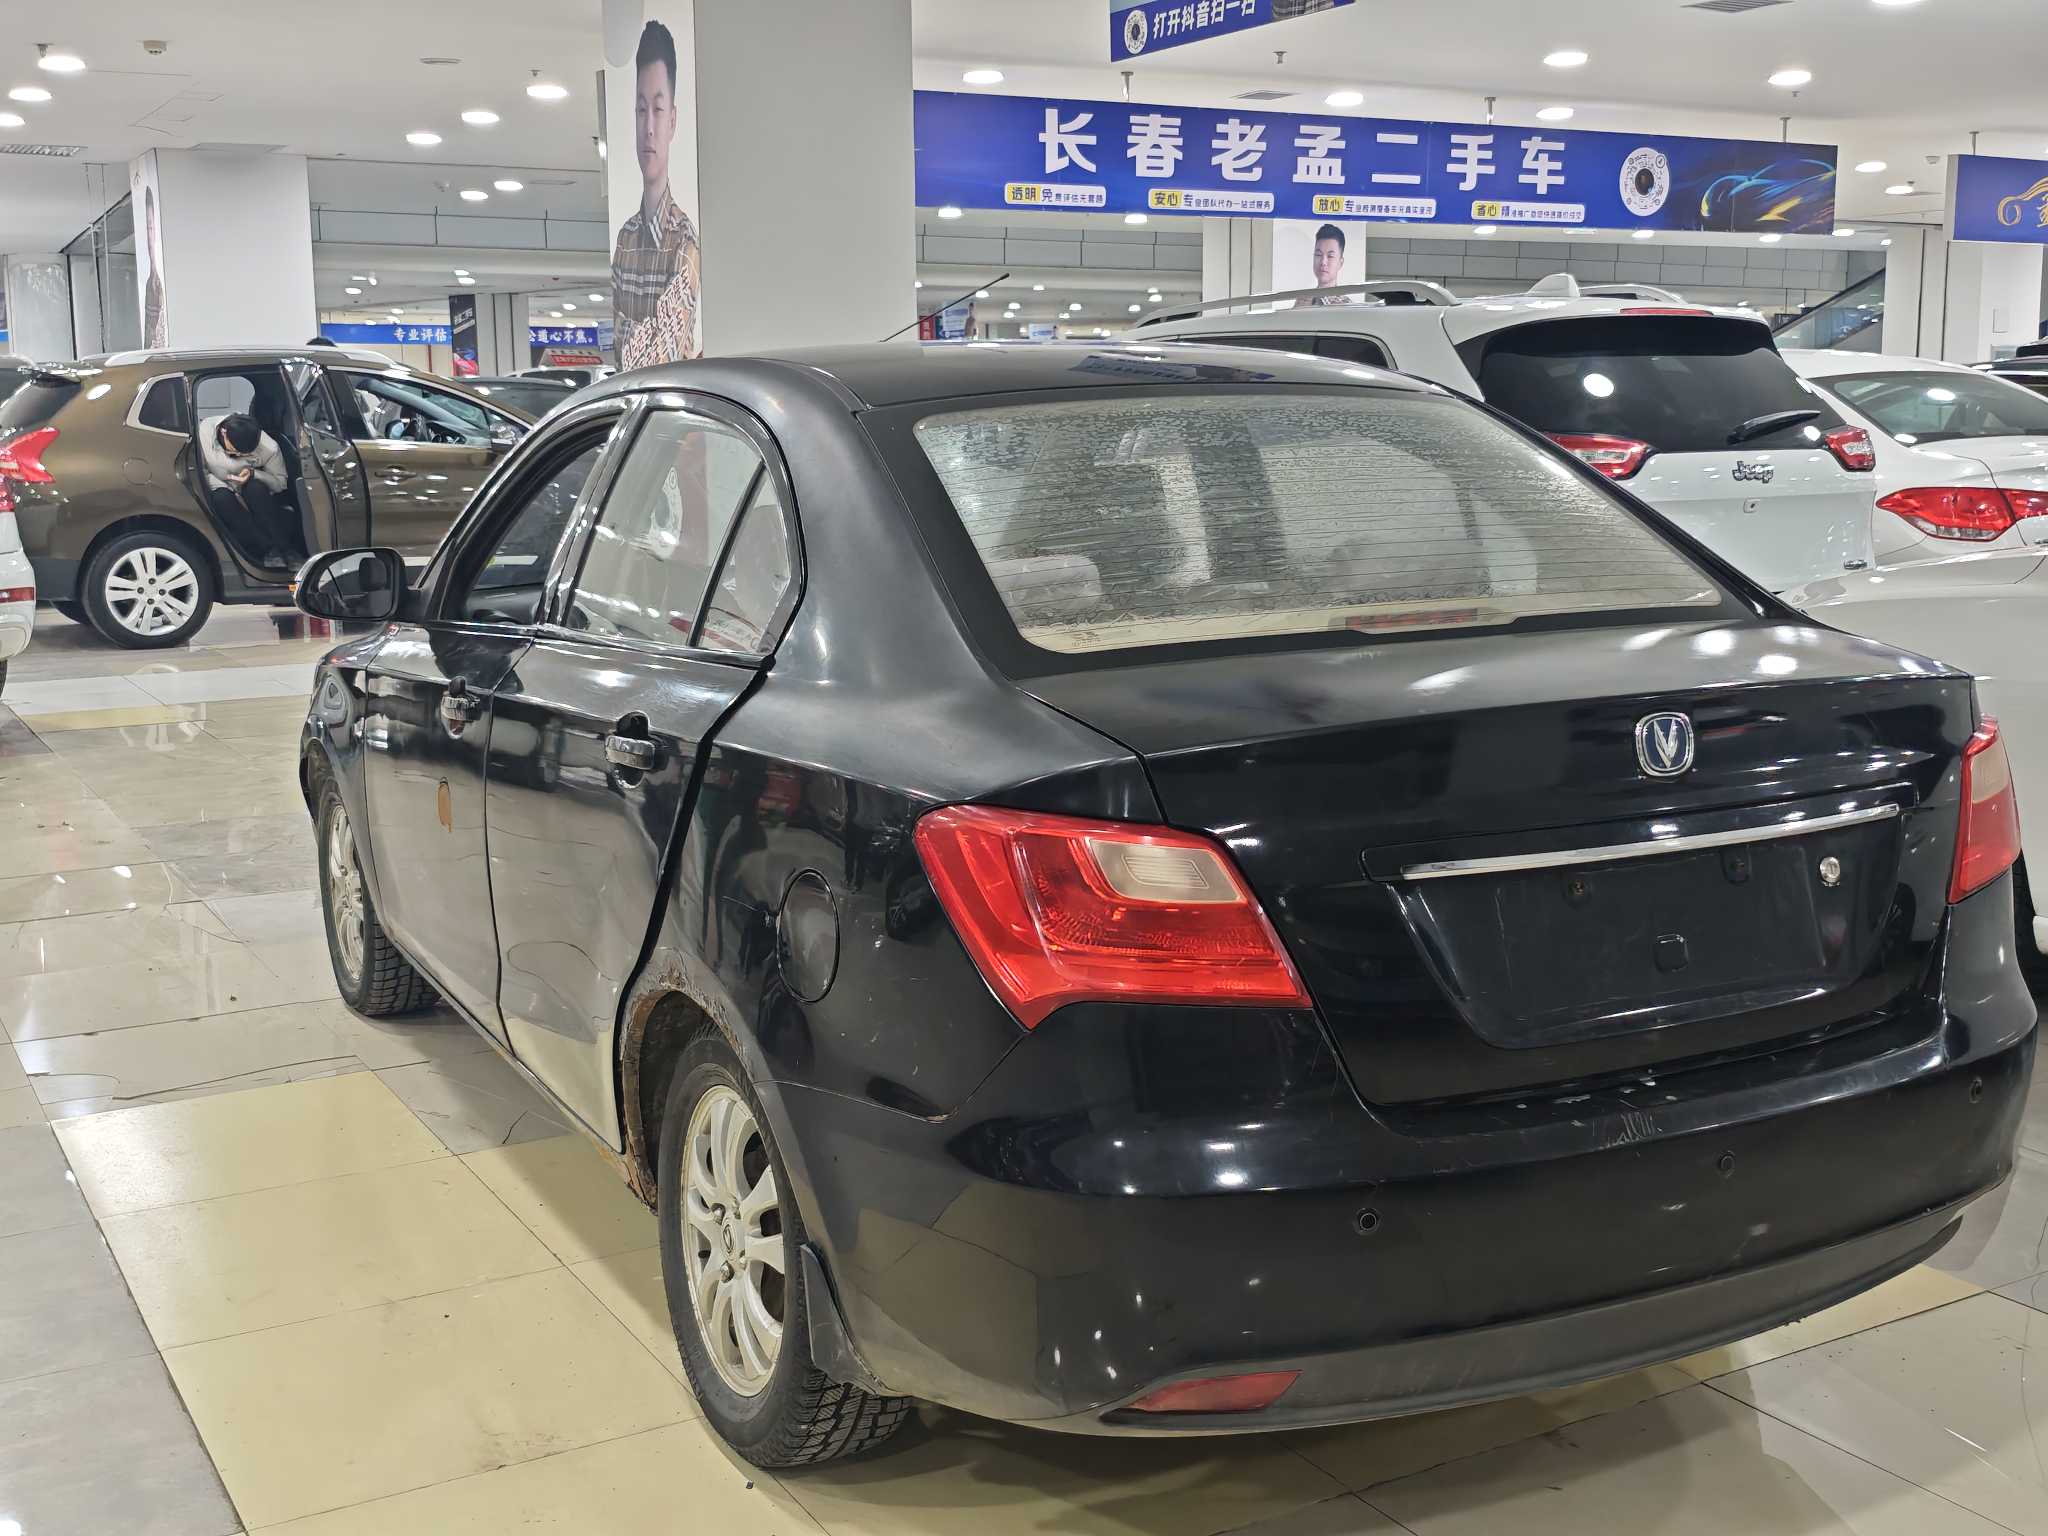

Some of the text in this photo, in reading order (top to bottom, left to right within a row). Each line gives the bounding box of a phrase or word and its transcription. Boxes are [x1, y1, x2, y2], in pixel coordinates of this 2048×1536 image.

[1152, 0, 1255, 39] 打开抖音扫一扫
[1039, 108, 1566, 195] 长春老孟二手车
[1012, 186, 1036, 201] 透明
[1154, 192, 1178, 206] 安心
[1318, 198, 1340, 212] 放心
[393, 327, 447, 343] 专业评估
[1732, 460, 1774, 484] Jeep
